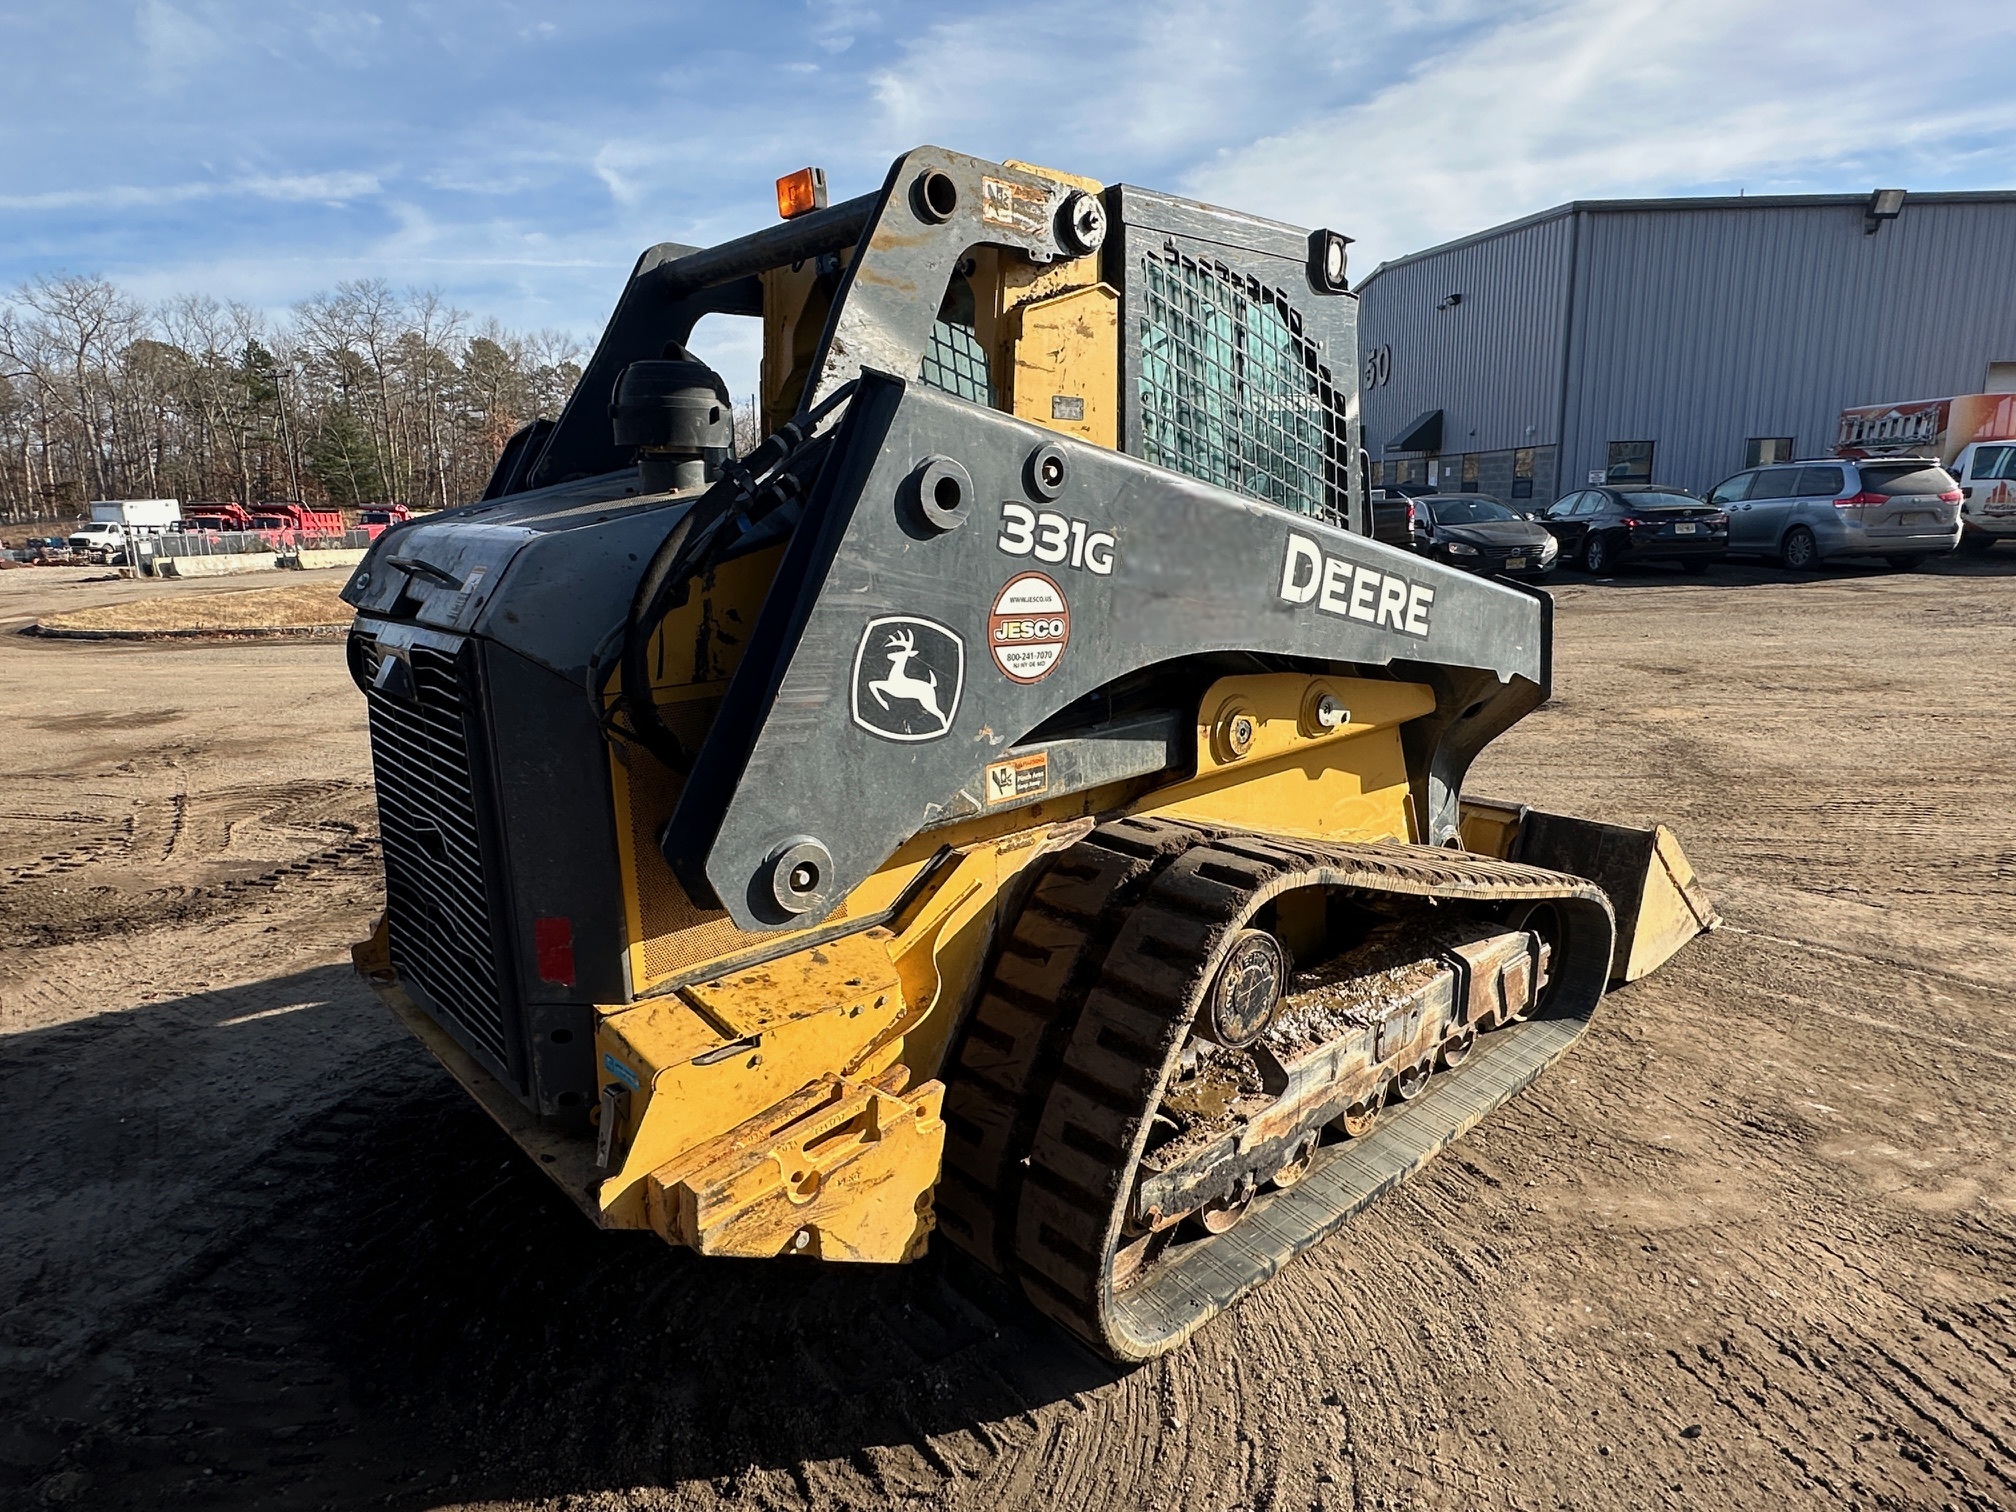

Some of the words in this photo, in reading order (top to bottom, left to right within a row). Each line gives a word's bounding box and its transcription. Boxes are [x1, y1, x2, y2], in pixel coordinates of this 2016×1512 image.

[1364, 343, 1391, 391] 50
[997, 503, 1116, 575] 331G
[1280, 532, 1435, 637] DEERE
[994, 619, 1065, 641] JESCO
[1007, 651, 1052, 661] 800-241-7070
